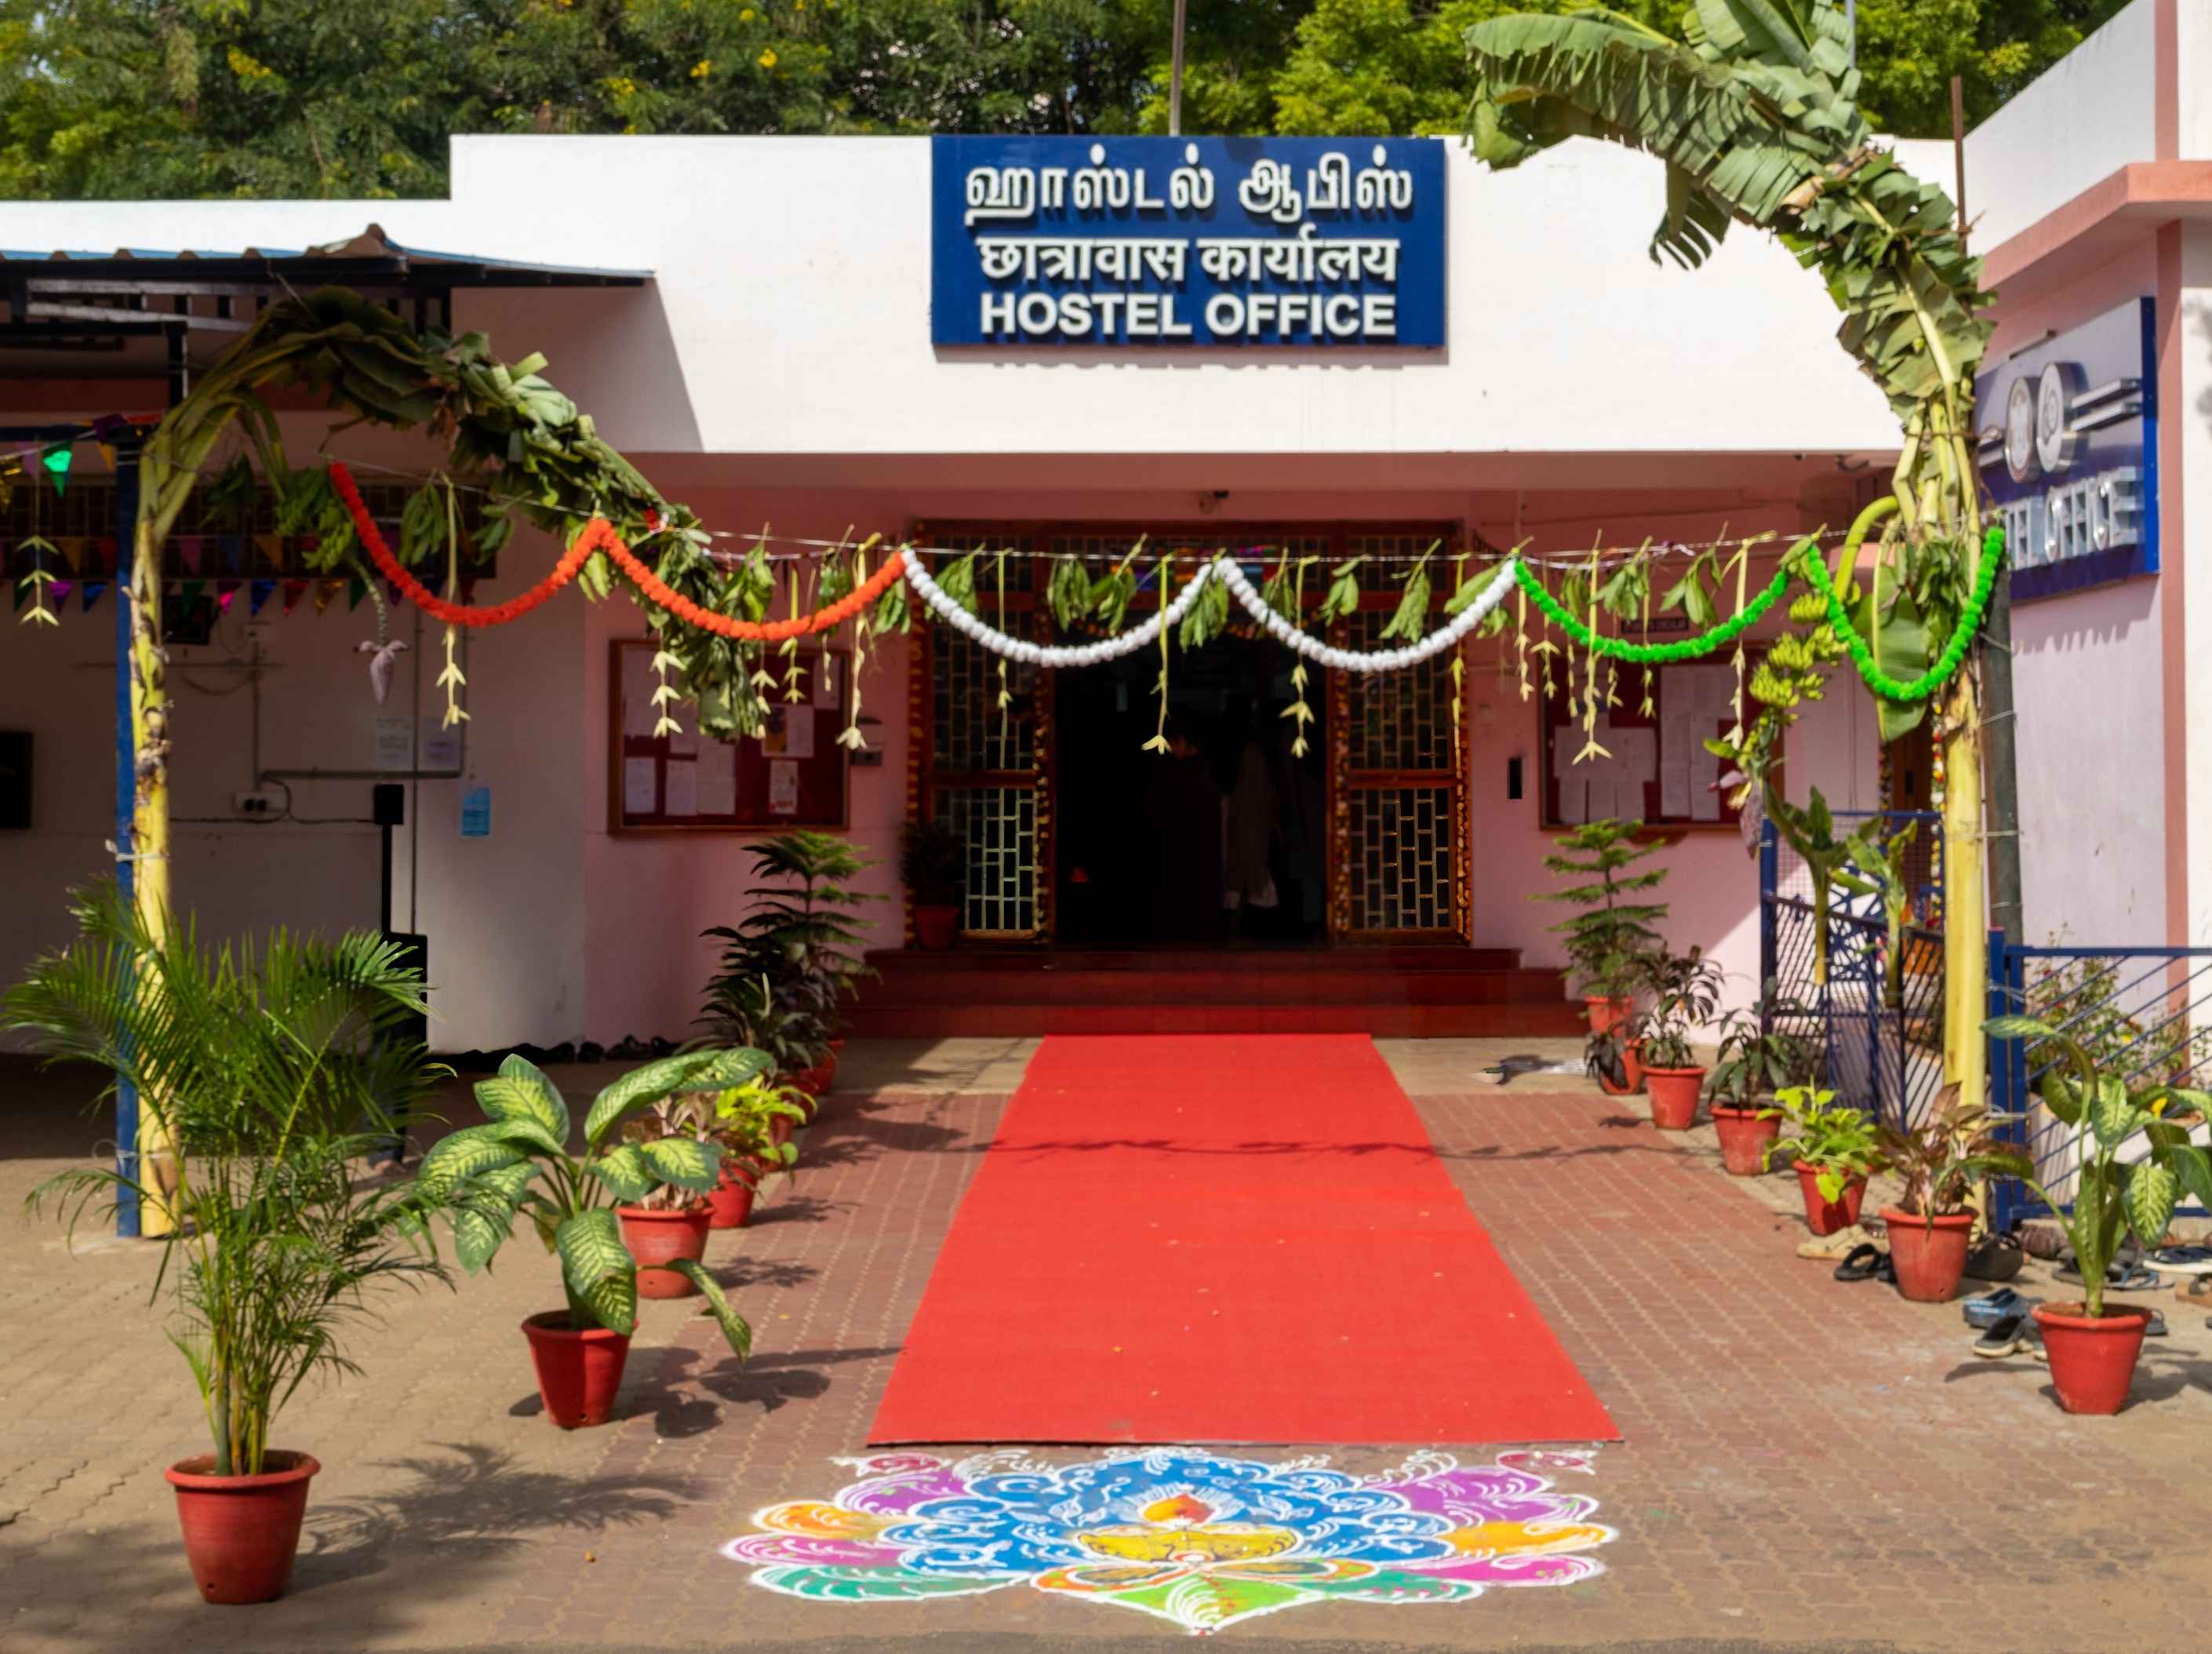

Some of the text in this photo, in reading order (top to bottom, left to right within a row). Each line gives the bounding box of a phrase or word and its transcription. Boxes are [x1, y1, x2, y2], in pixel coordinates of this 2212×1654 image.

[965, 144, 1412, 225] ஹாஸ்டல் ஆபிஸ்
[976, 223, 1400, 281] छात्रावास कार्यालय
[982, 293, 1395, 335] HOSTEL OFFICE
[2045, 467, 2139, 563] OFFICE
